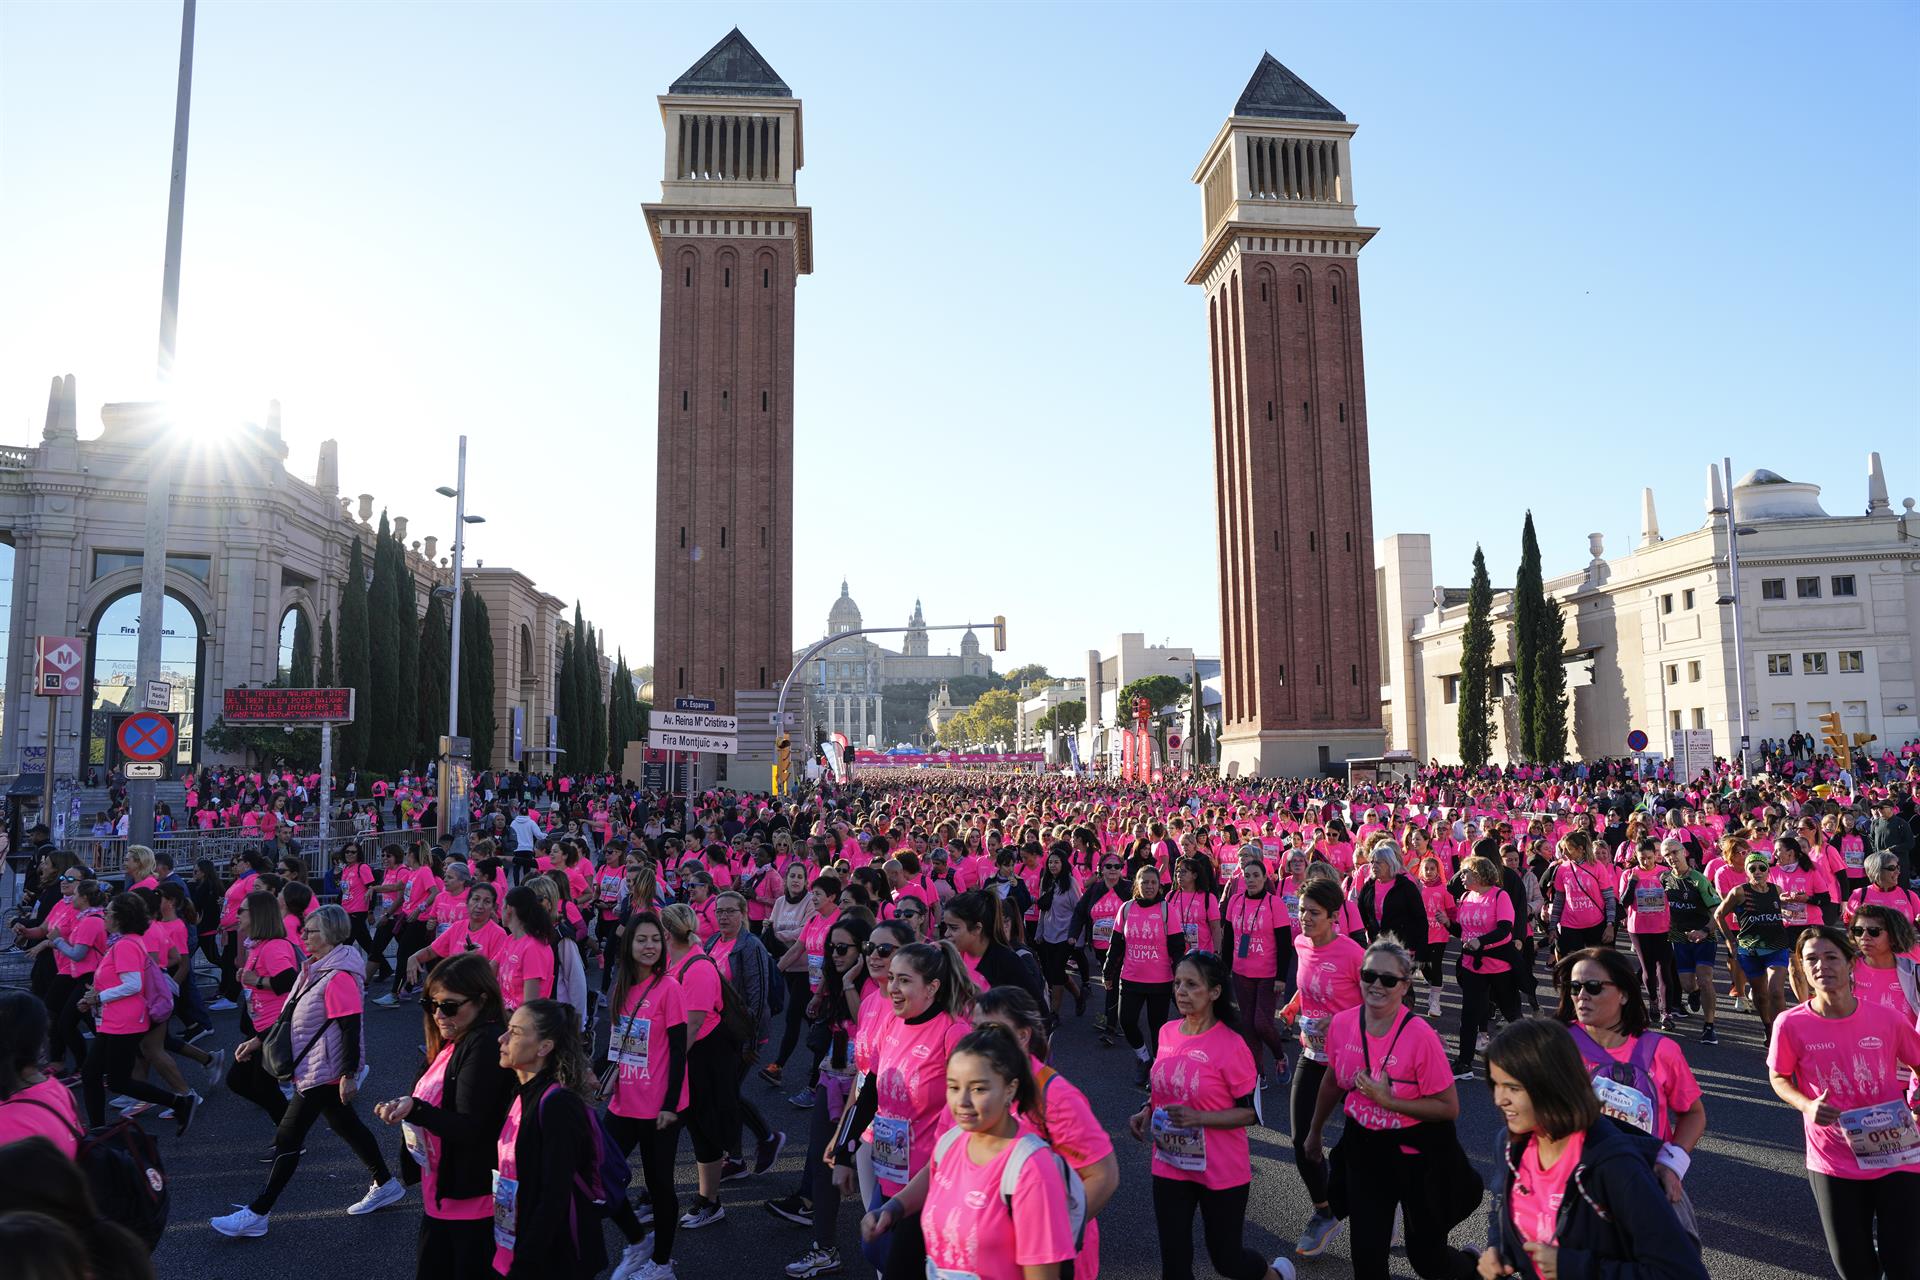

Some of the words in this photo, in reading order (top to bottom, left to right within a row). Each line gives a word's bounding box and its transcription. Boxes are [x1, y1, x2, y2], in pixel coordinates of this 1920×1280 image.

[120, 626, 136, 634] Fira
[57, 651, 72, 665] M
[689, 701, 709, 710] Espanya
[663, 714, 674, 725] Av.
[675, 715, 694, 726] Reina
[694, 716, 703, 727] Mª
[703, 717, 728, 728] Cristina
[662, 733, 677, 746] Fira
[678, 735, 711, 749] Montjuïc
[1805, 1041, 1836, 1052] OYSHO
[619, 1063, 651, 1080] UMA
[1163, 1133, 1186, 1145] 016
[1868, 1127, 1900, 1144] 016
